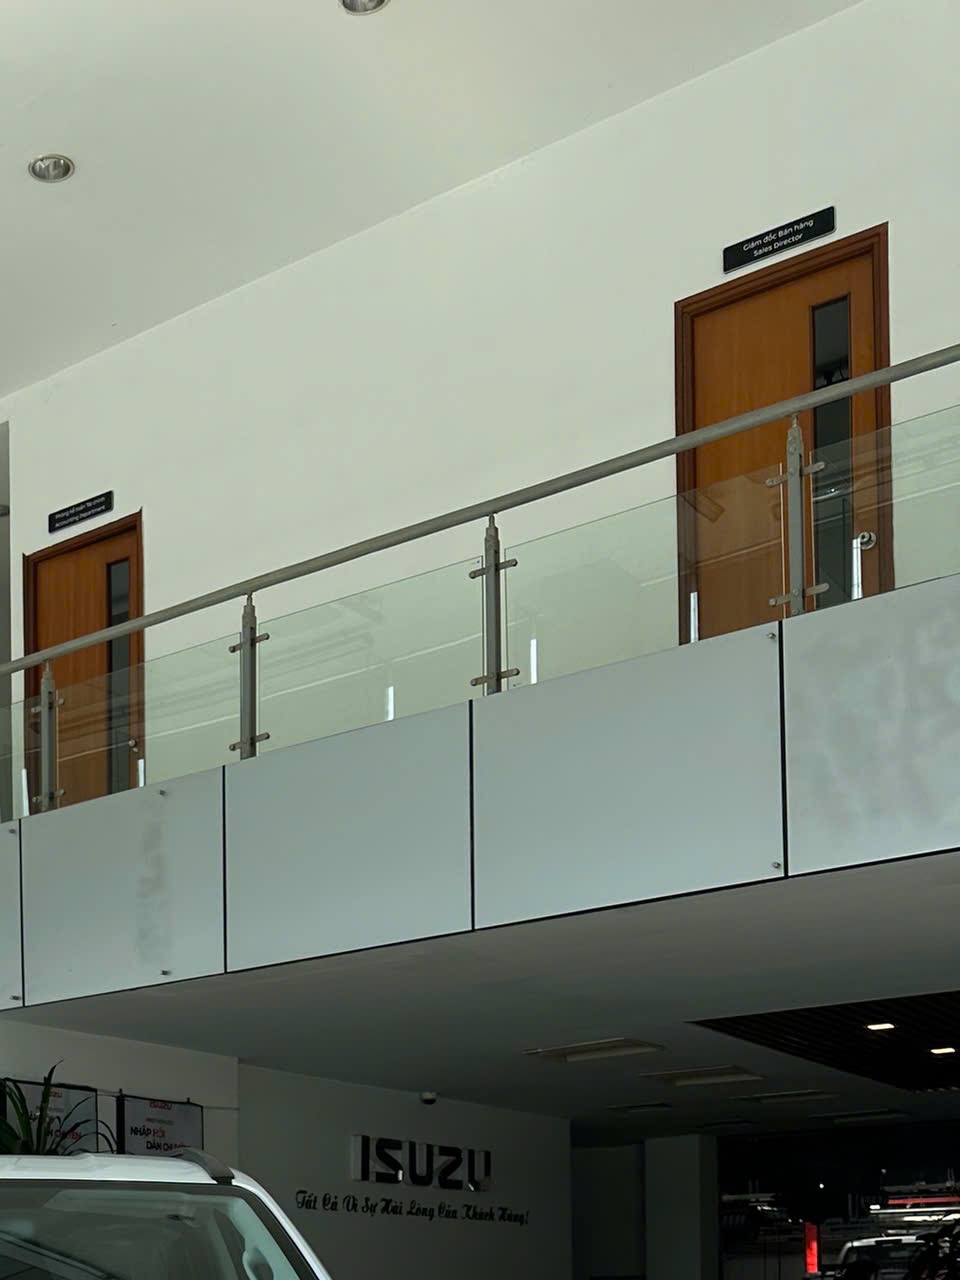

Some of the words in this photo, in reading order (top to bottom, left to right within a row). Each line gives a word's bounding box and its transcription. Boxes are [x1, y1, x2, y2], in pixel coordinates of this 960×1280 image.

[778, 225, 793, 238] Bán
[794, 219, 814, 232] hàng
[753, 244, 773, 257] Sales
[773, 233, 803, 249] Director
[352, 1135, 493, 1192] ISUZU
[296, 1190, 318, 1210] Tất
[322, 1193, 338, 1212] Cả
[361, 1196, 378, 1217] Sự
[407, 1200, 435, 1221] Lòng
